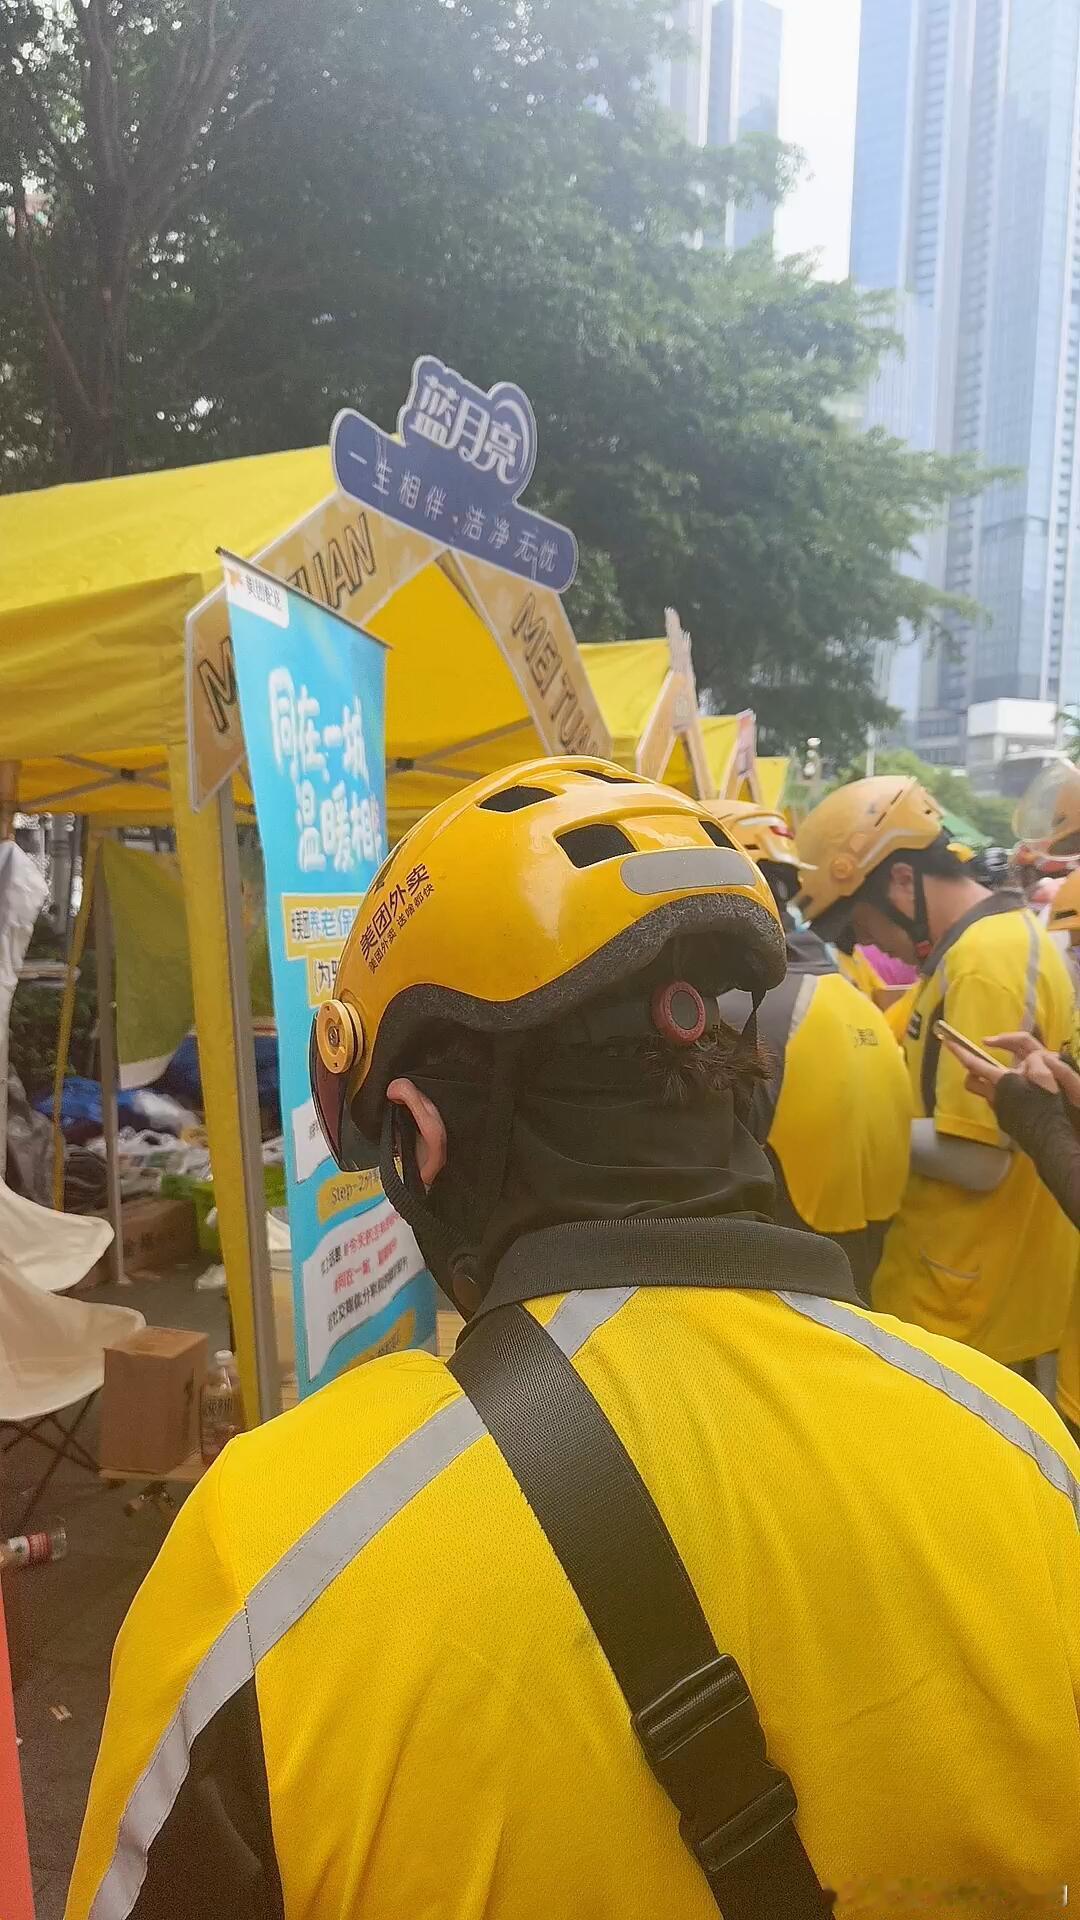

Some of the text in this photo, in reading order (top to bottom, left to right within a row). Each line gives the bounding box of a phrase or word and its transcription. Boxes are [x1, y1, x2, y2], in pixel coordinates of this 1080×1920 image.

[409, 375, 522, 485] 蓝月亮
[512, 591, 602, 756] MEI TUA
[360, 863, 430, 961] 美团外卖
